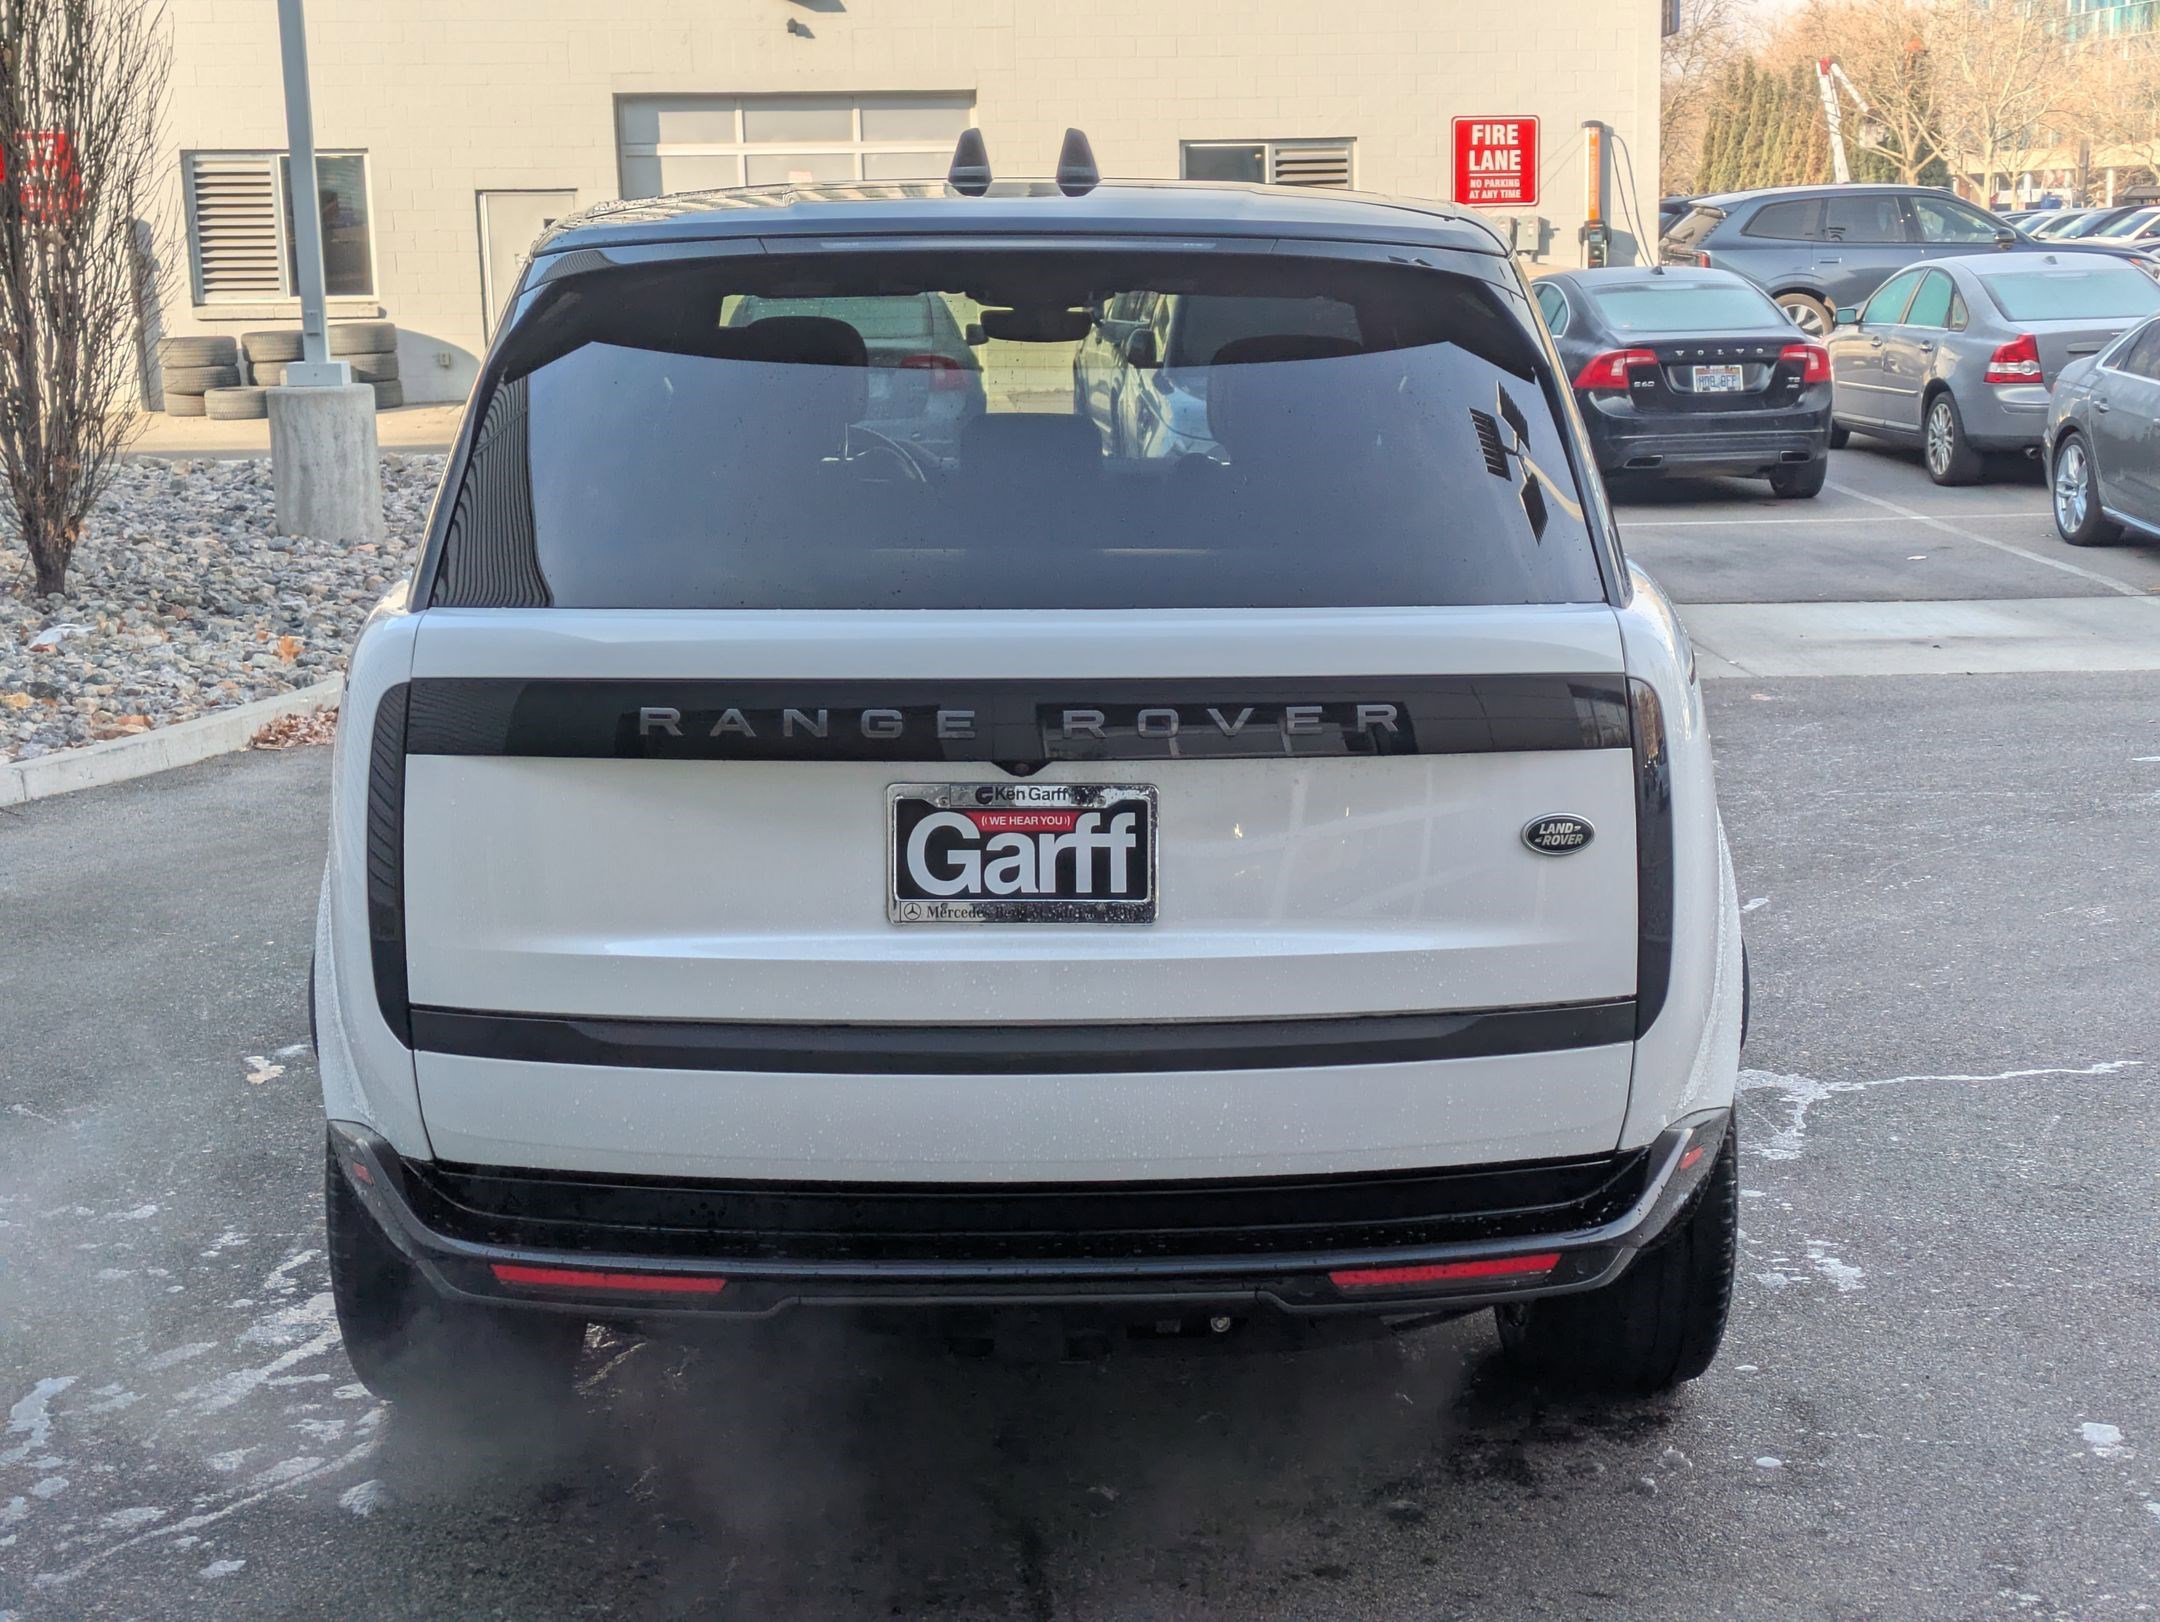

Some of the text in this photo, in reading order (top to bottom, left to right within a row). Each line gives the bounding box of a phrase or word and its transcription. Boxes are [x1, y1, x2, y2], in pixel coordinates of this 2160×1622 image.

[1471, 124, 1519, 145] FIRE
[1469, 149, 1521, 171] LANE
[1470, 178, 1520, 188] NO PARKING
[1469, 189, 1521, 199] AT ANY TIME
[1675, 348, 1764, 356] VOLVO
[639, 704, 1399, 739] RANGE ROVER
[995, 786, 1068, 801] Ken Garff
[1009, 816, 1038, 826] HEAR
[1542, 834, 1583, 845] ROVER
[907, 811, 1137, 896] Garff
